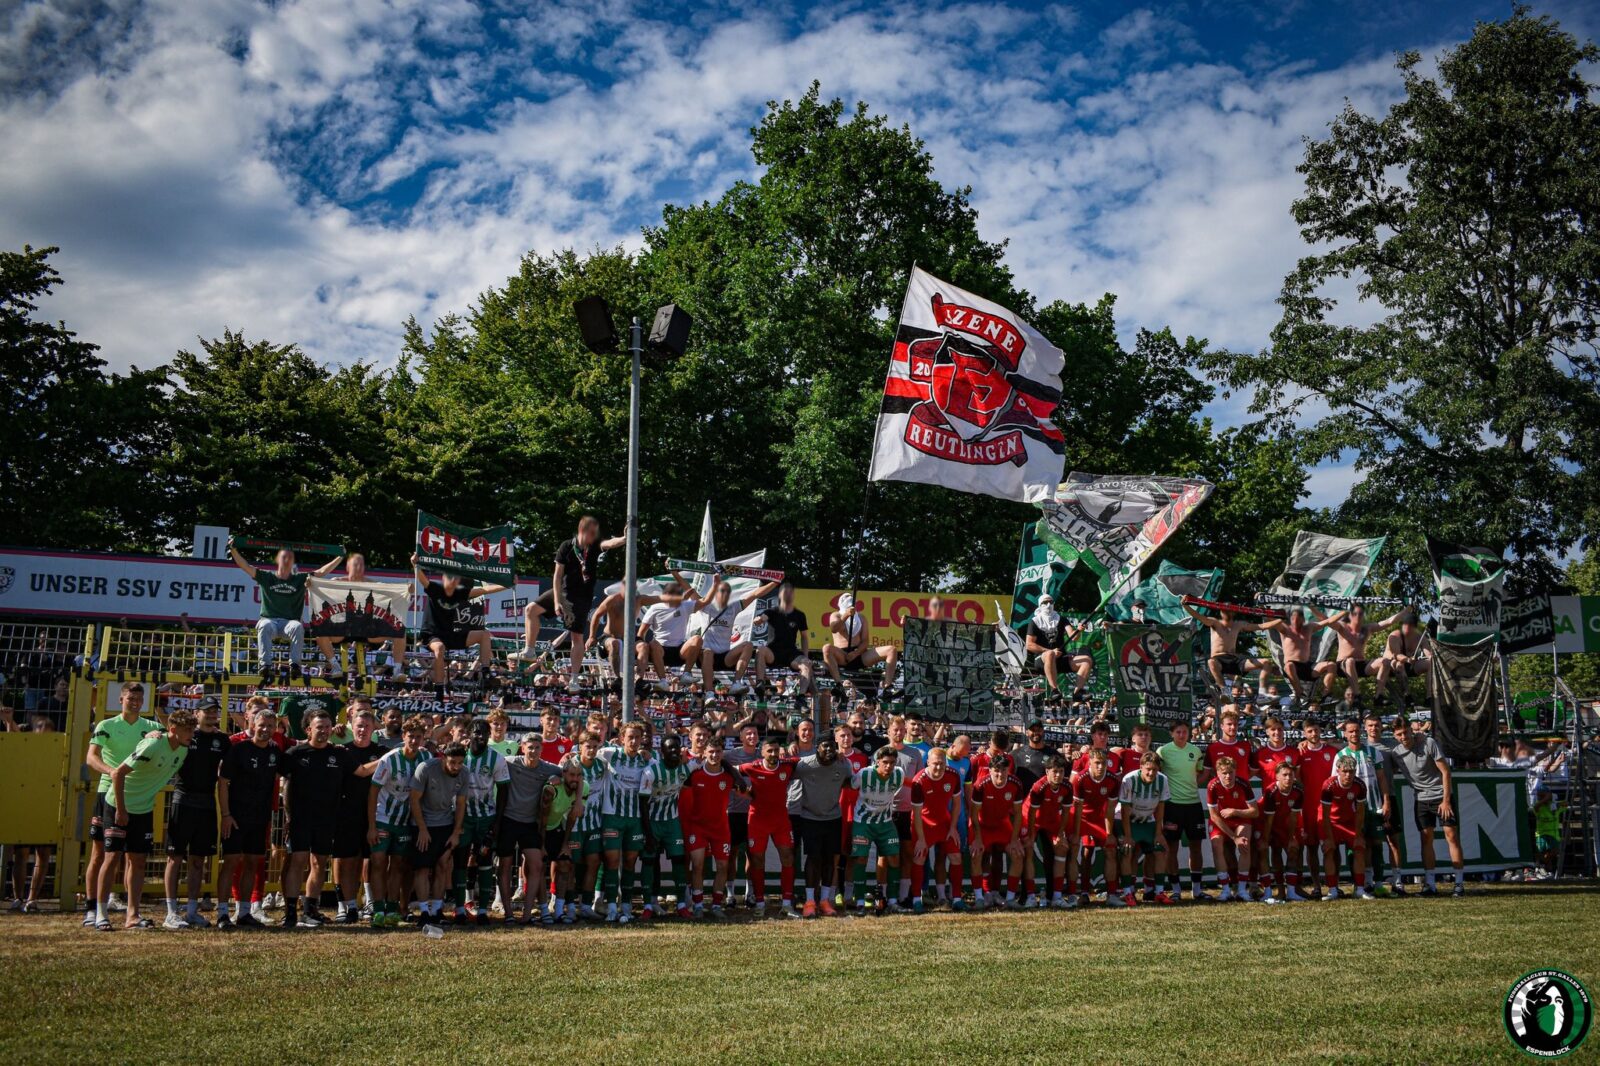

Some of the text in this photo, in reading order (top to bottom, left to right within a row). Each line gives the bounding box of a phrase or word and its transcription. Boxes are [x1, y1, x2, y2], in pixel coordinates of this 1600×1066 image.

[487, 566, 511, 575] GALLEN
[30, 573, 107, 595] UNSER
[117, 578, 162, 597] SSV
[169, 582, 245, 603] STEHT
[503, 599, 526, 608] UNER
[507, 609, 521, 617] SV
[871, 597, 985, 628] LOTTO
[1119, 664, 1190, 693] ISATZ
[904, 683, 994, 725] 2009
